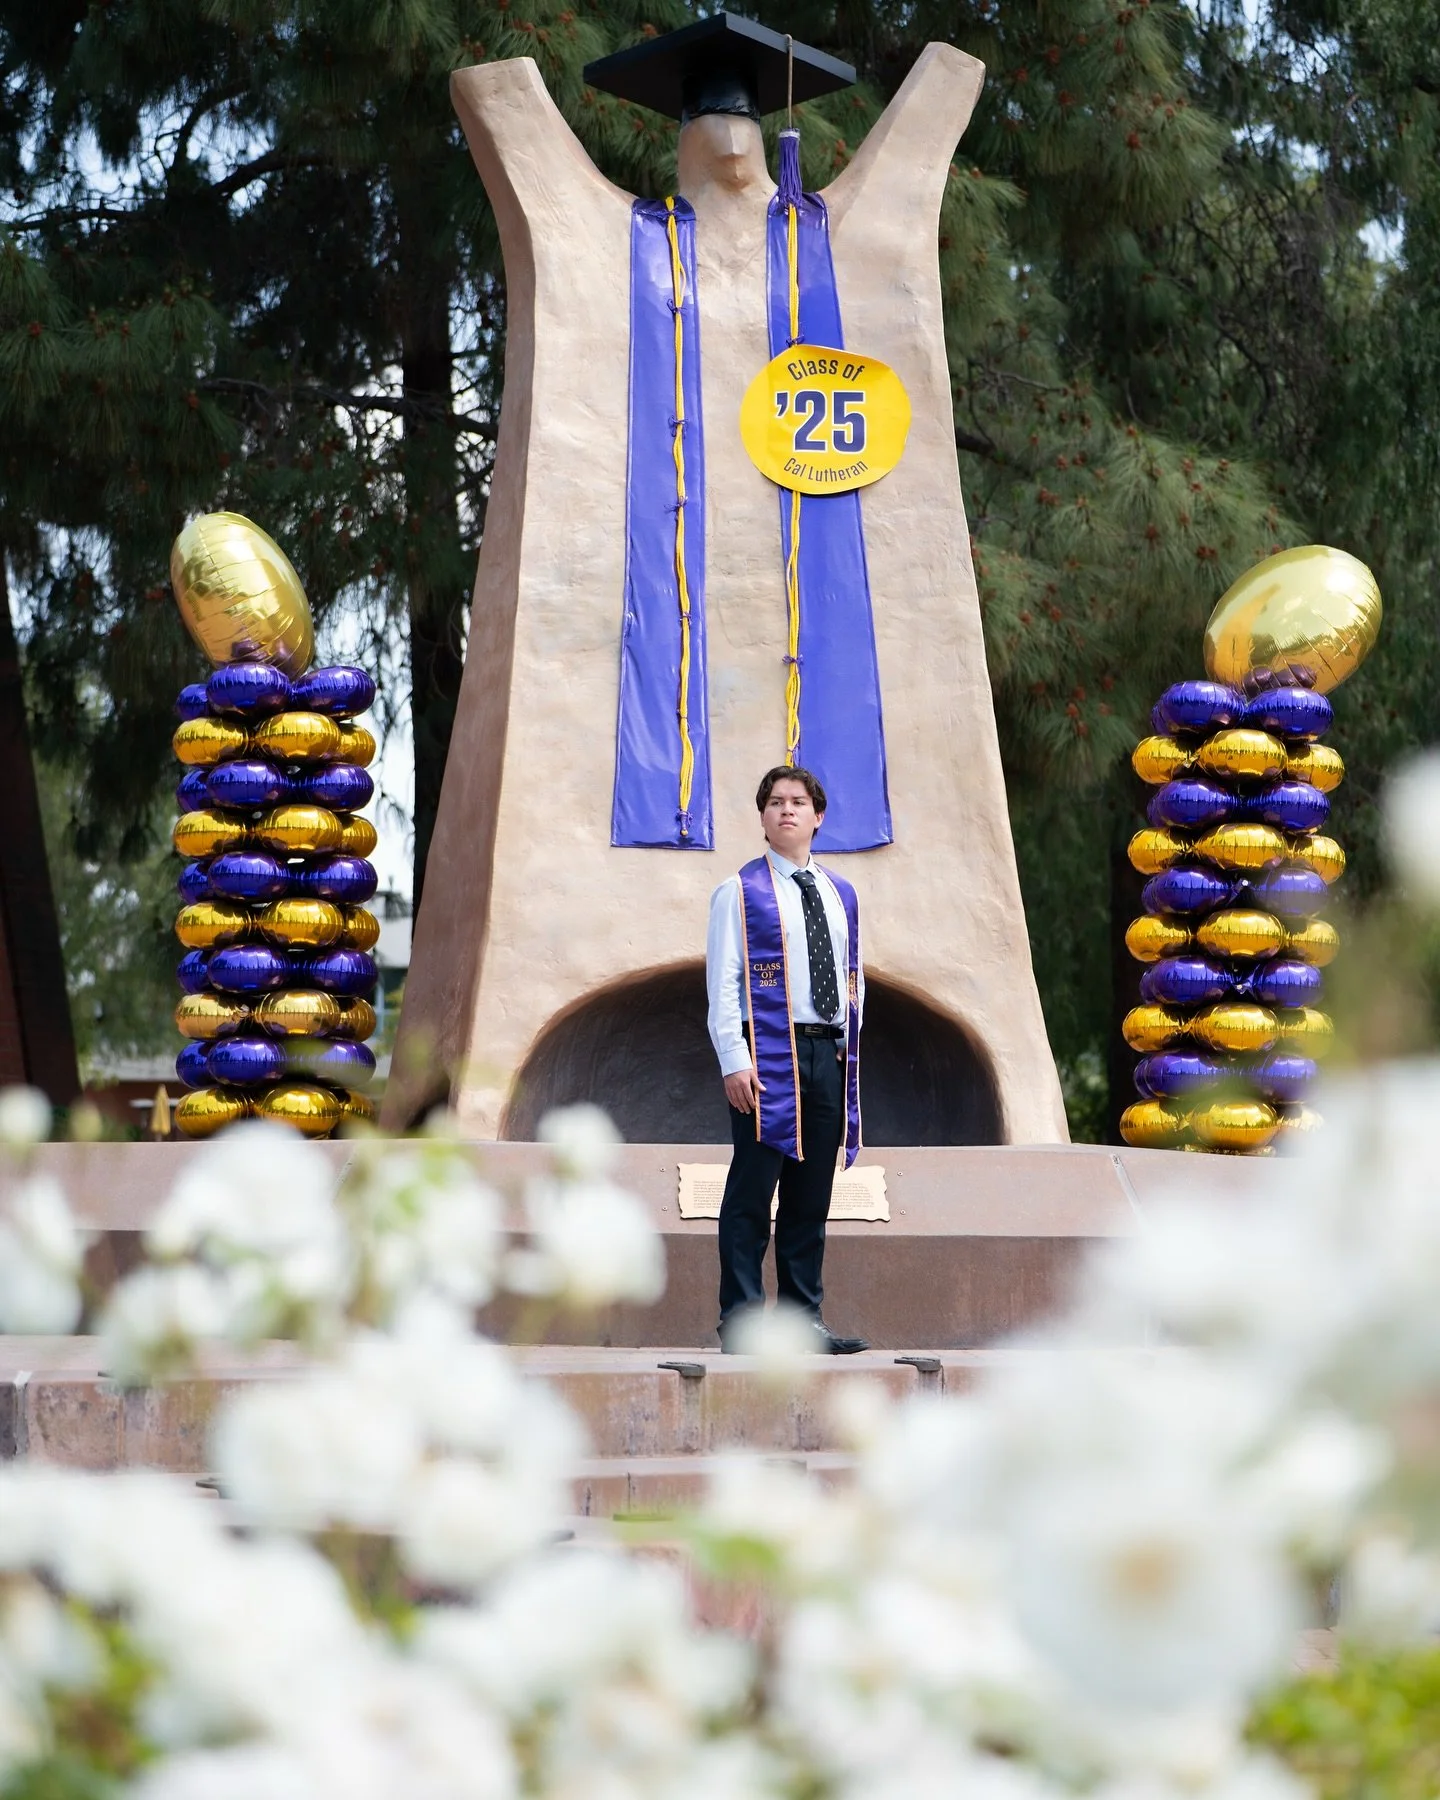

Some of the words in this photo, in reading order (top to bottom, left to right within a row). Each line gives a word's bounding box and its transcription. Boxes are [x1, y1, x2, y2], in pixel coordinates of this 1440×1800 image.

[787, 359, 839, 381] Class
[842, 364, 866, 382] of
[783, 457, 807, 477] Cal
[807, 460, 869, 482] Lutheran
[753, 962, 781, 971] CLASS
[761, 971, 774, 979] OF
[759, 979, 778, 987] 2025
